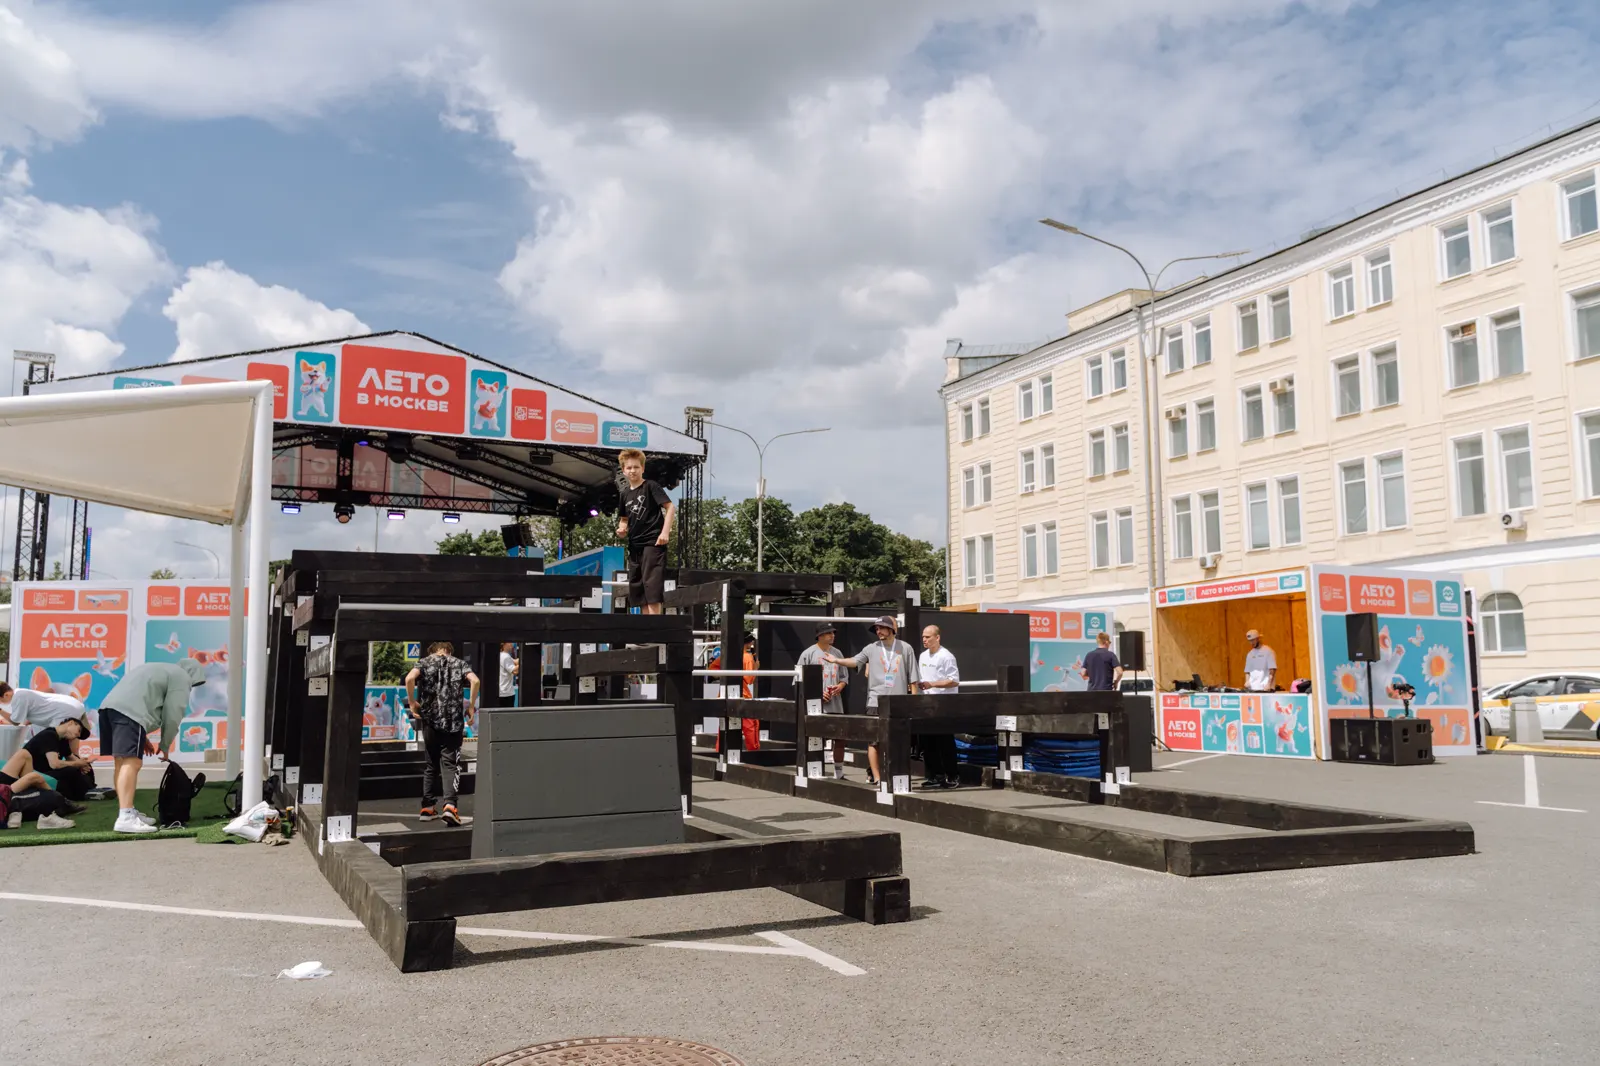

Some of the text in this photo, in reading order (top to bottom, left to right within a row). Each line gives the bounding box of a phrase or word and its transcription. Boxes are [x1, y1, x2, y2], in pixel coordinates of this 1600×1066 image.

[358, 367, 450, 397] ЛЕТО
[357, 392, 449, 413] В МОСКВЕ
[1200, 587, 1217, 597] ЛЕТО
[1224, 583, 1251, 593] МОСКВЕ
[1360, 583, 1395, 598] ЛЕТО
[197, 592, 231, 603] ЛЕТ
[1367, 599, 1396, 607] МОСКВЕ
[1029, 616, 1050, 626] ЕТО
[41, 623, 108, 638] ЛЕТО
[41, 640, 107, 649] В МОСКВЕ
[1168, 720, 1197, 731] ЛЕТО
